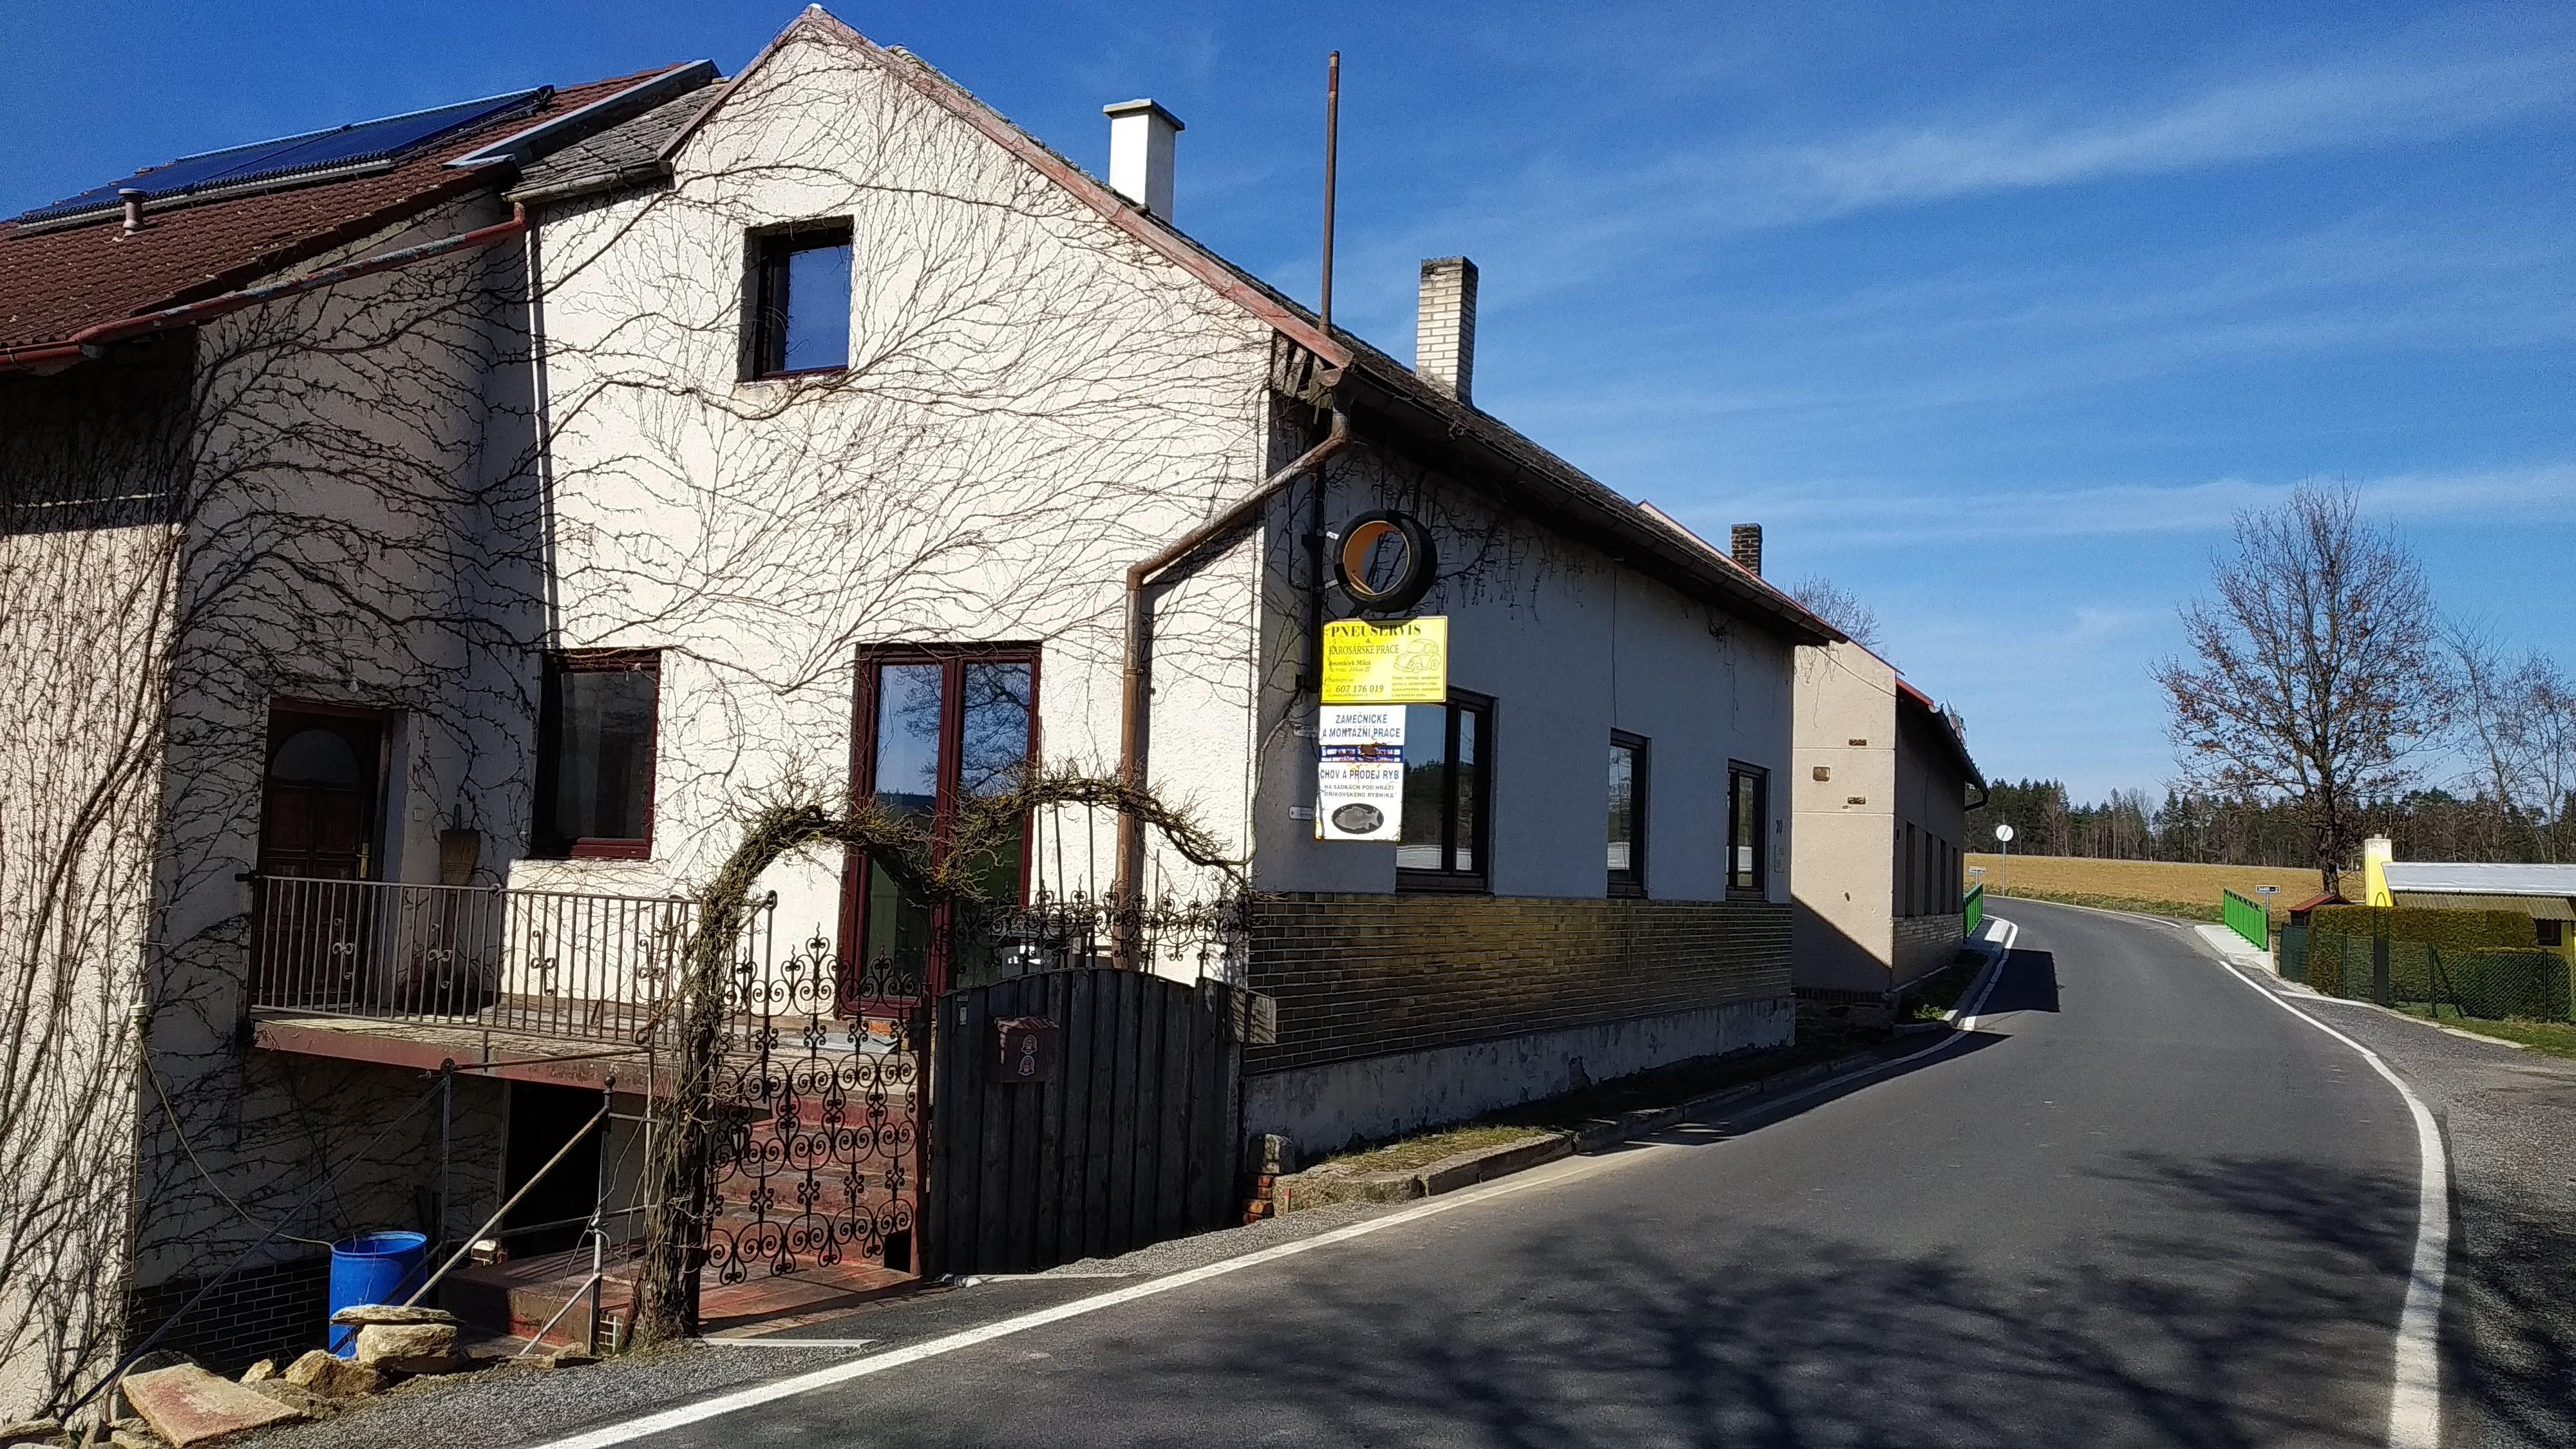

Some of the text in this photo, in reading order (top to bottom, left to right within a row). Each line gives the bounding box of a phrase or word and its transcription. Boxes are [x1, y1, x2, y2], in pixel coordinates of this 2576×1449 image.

[1331, 623, 1421, 638] PNEUSERVIS
[1376, 643, 1399, 654] PRÁCE
[1336, 685, 1351, 693] 607
[1353, 685, 1367, 693] 176
[1369, 685, 1384, 693] 019
[1335, 712, 1388, 724] ZÁMEČNICKÉ
[1322, 728, 1327, 737] A
[1373, 725, 1401, 737] PRÁCE
[1320, 769, 1399, 779] CHOV A PRODEJ RYB
